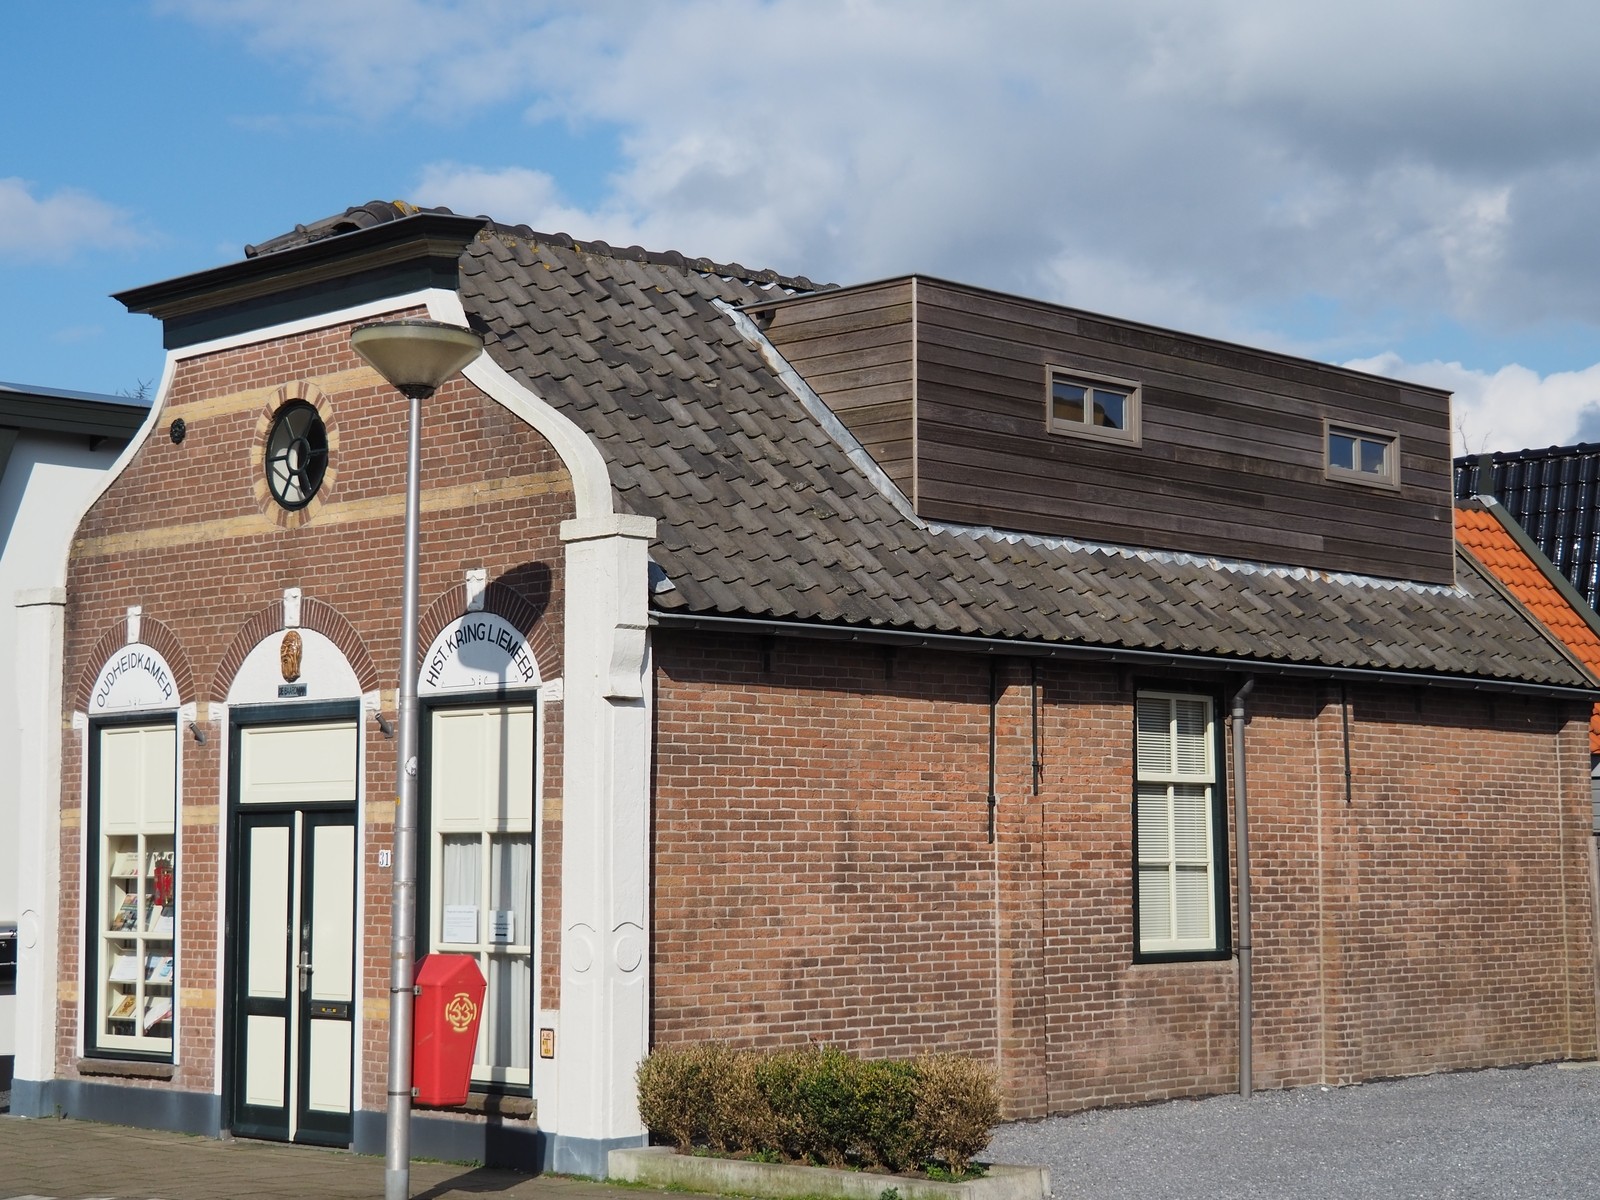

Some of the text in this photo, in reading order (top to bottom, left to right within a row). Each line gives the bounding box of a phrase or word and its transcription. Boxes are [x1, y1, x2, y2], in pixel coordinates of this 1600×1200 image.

[96, 652, 173, 708] OUDHEIDKAMER
[426, 622, 534, 688] HIST. KRING LIEMEER
[379, 851, 389, 866] 31
